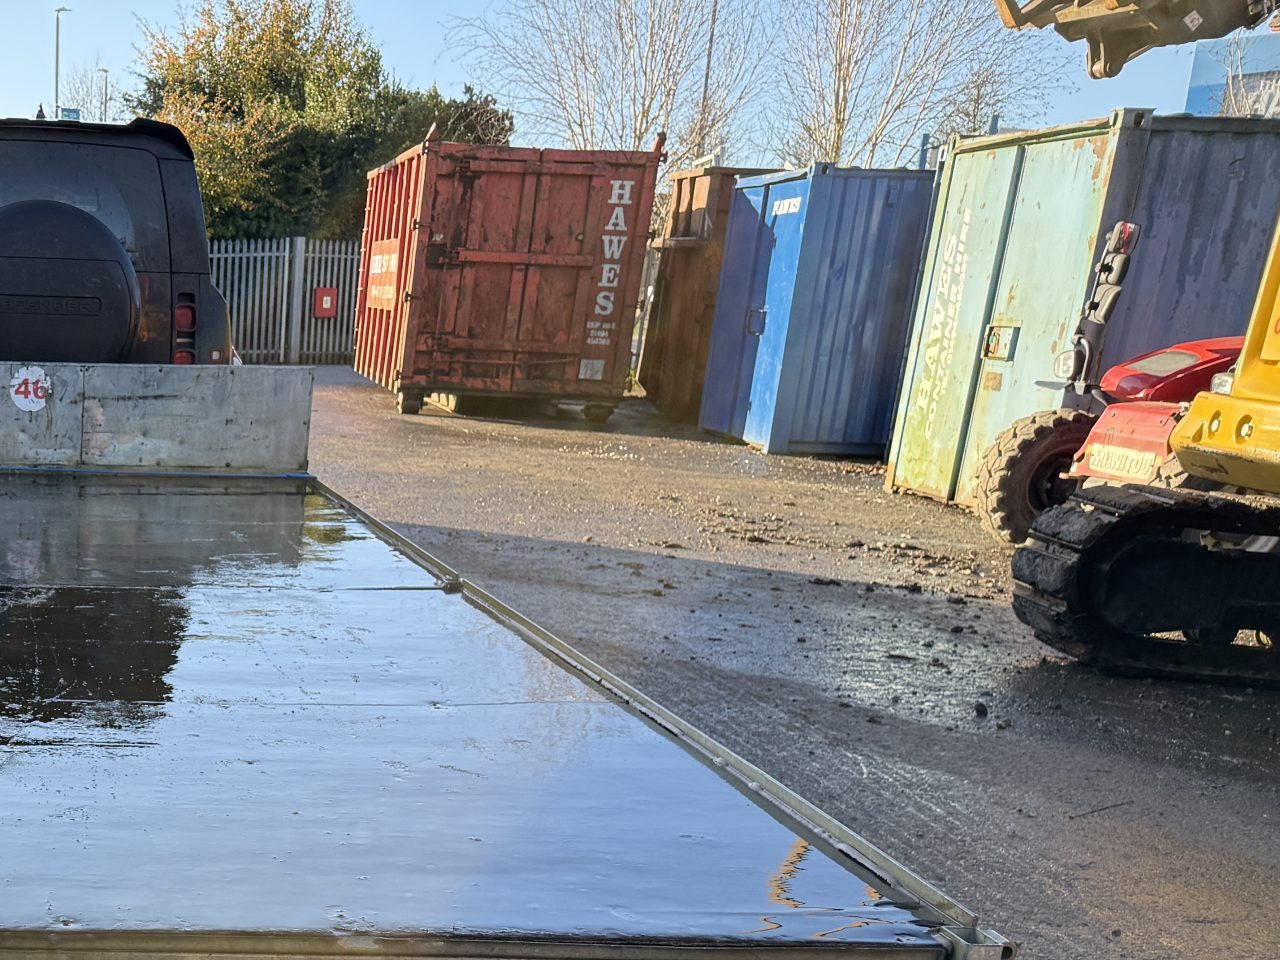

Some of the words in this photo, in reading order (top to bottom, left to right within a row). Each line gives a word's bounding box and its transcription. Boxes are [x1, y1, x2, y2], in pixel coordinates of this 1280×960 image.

[594, 179, 635, 316] HAWES
[15, 378, 48, 399] 46
[915, 231, 957, 415] HAWES
